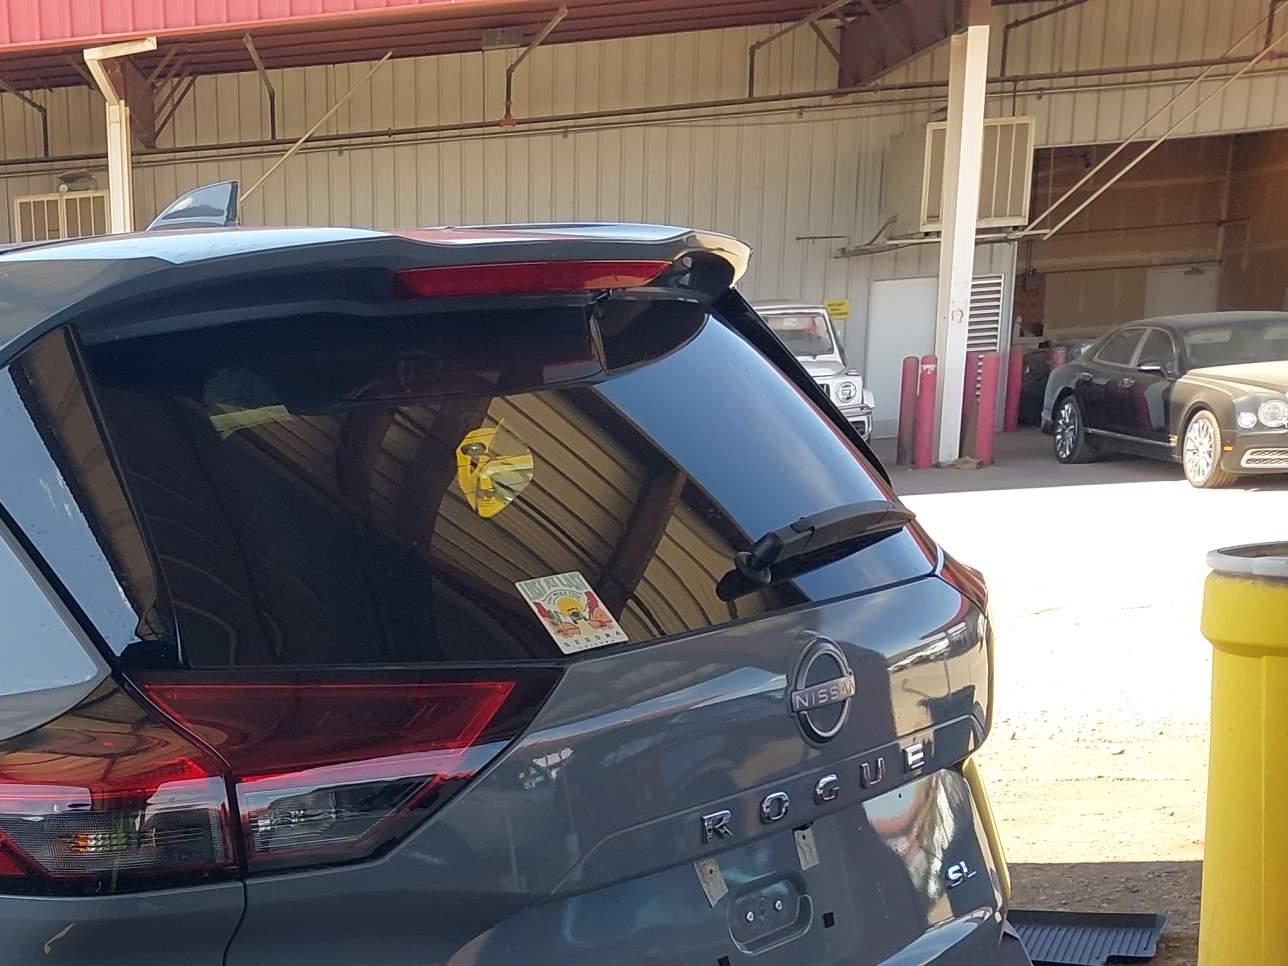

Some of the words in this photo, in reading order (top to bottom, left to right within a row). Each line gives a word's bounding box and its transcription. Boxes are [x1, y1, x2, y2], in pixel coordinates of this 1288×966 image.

[794, 678, 855, 709] NISSAN
[702, 743, 925, 844] ROGUE
[948, 861, 976, 887] SL
